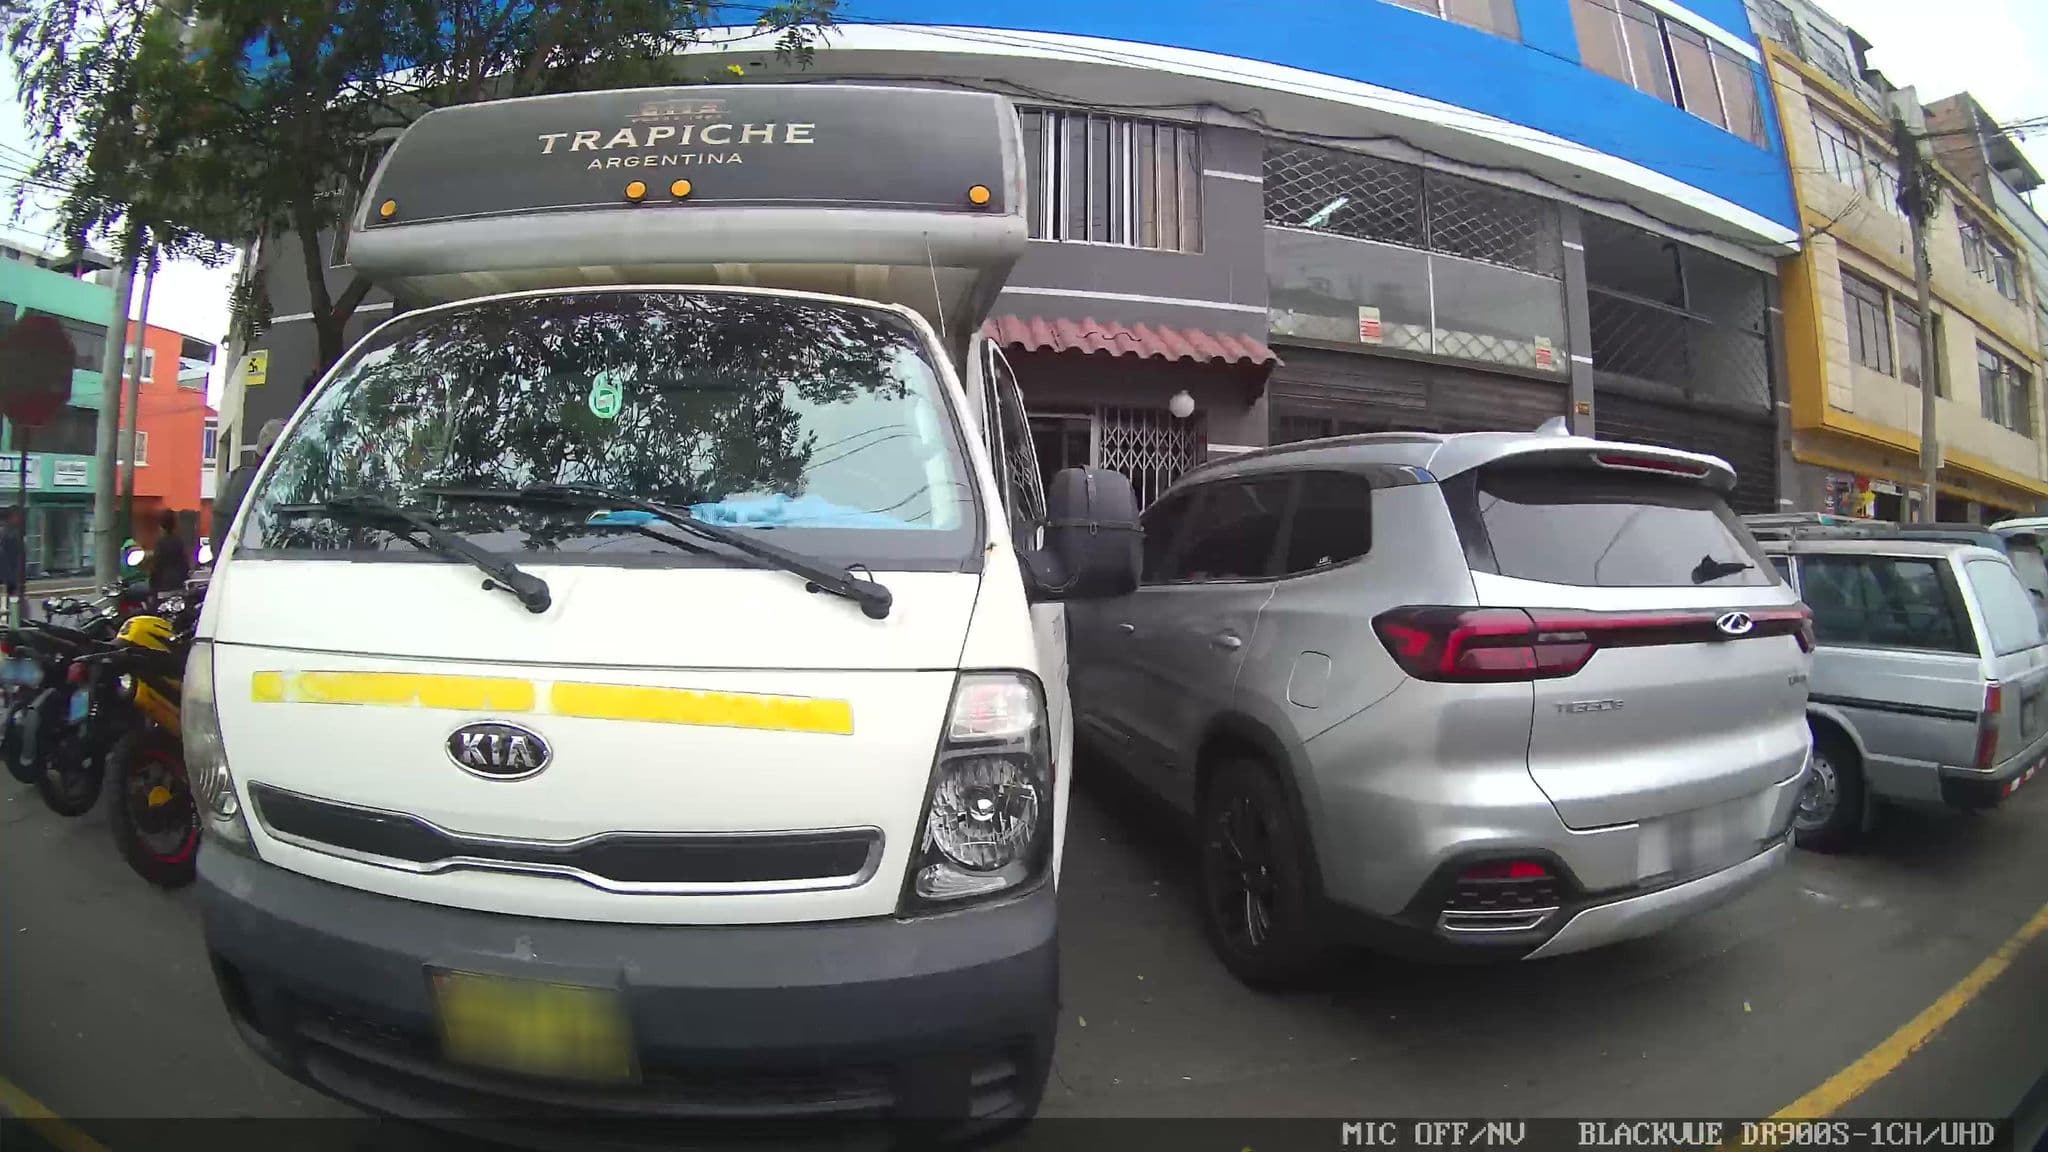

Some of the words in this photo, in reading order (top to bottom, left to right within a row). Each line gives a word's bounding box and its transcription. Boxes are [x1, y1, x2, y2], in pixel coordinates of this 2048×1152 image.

[538, 123, 815, 154] TRAPICHE
[587, 152, 743, 170] ARGENTINA
[460, 732, 537, 767] KIA
